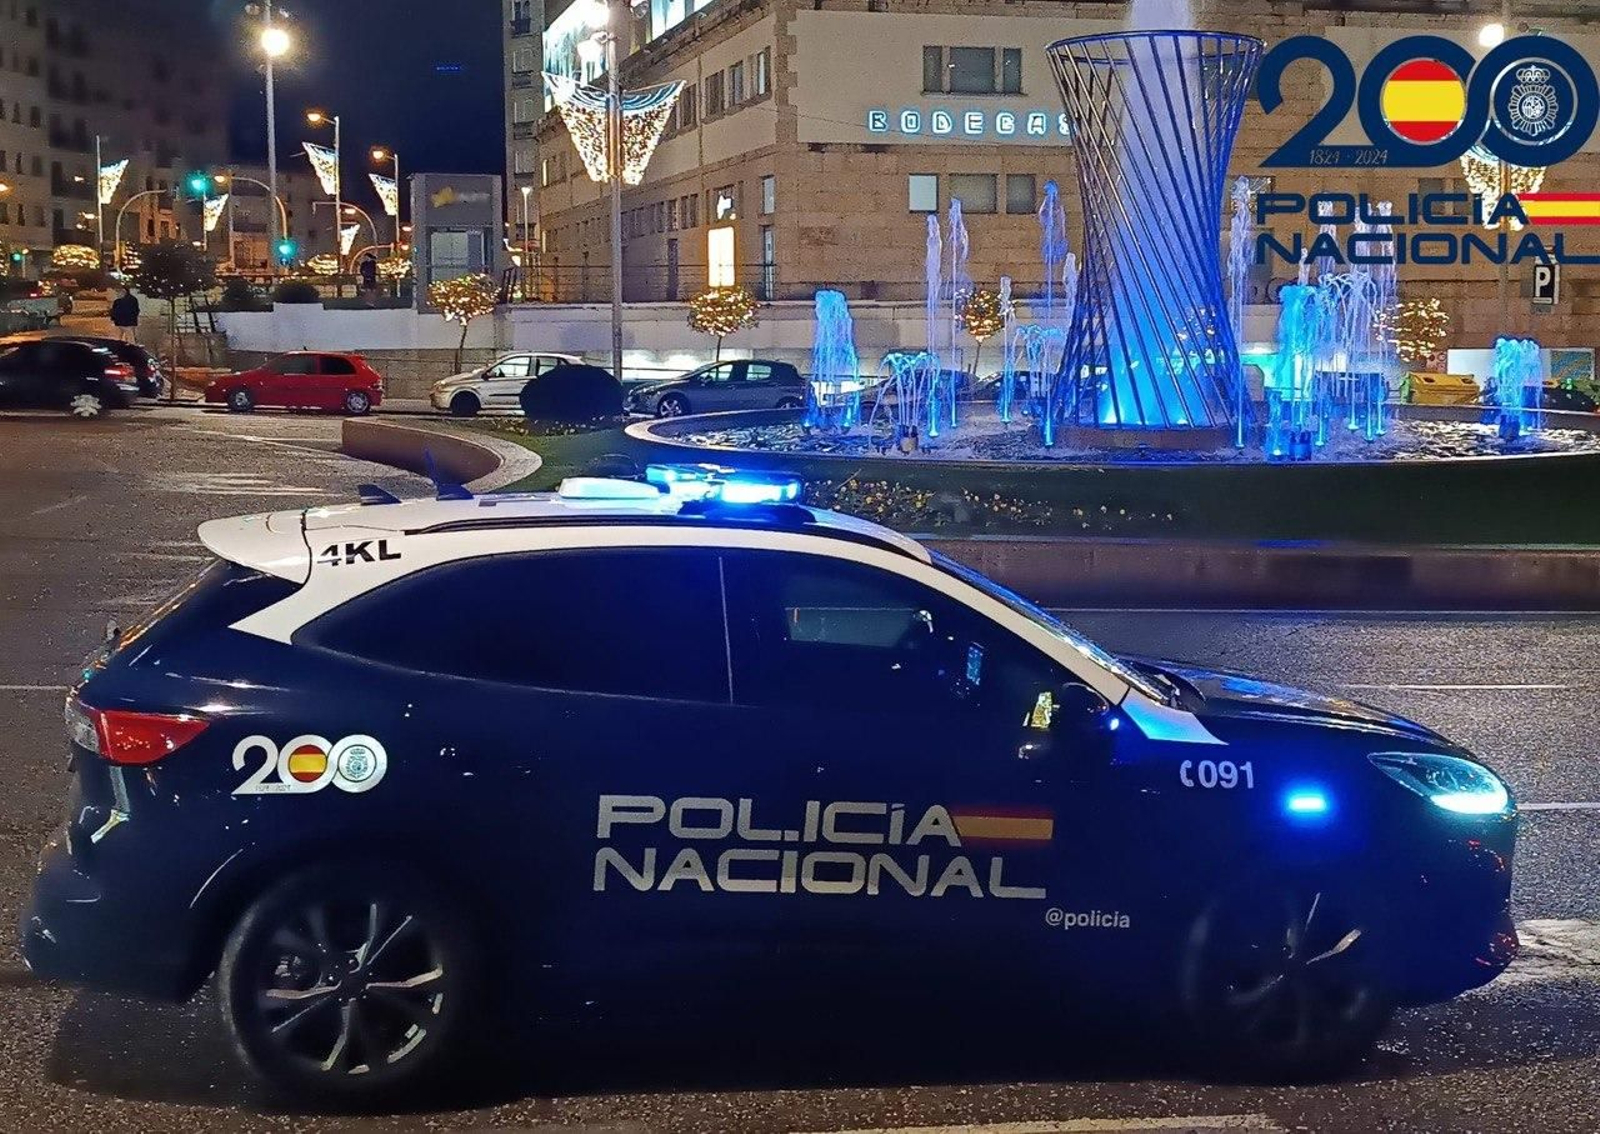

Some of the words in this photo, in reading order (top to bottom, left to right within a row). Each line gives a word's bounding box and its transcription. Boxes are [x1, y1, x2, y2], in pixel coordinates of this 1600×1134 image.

[1535, 266, 1551, 297] P
[317, 539, 402, 566] 4KL
[231, 734, 388, 795] 200
[1198, 760, 1254, 789] 091
[593, 847, 1047, 899] NACIONAL
